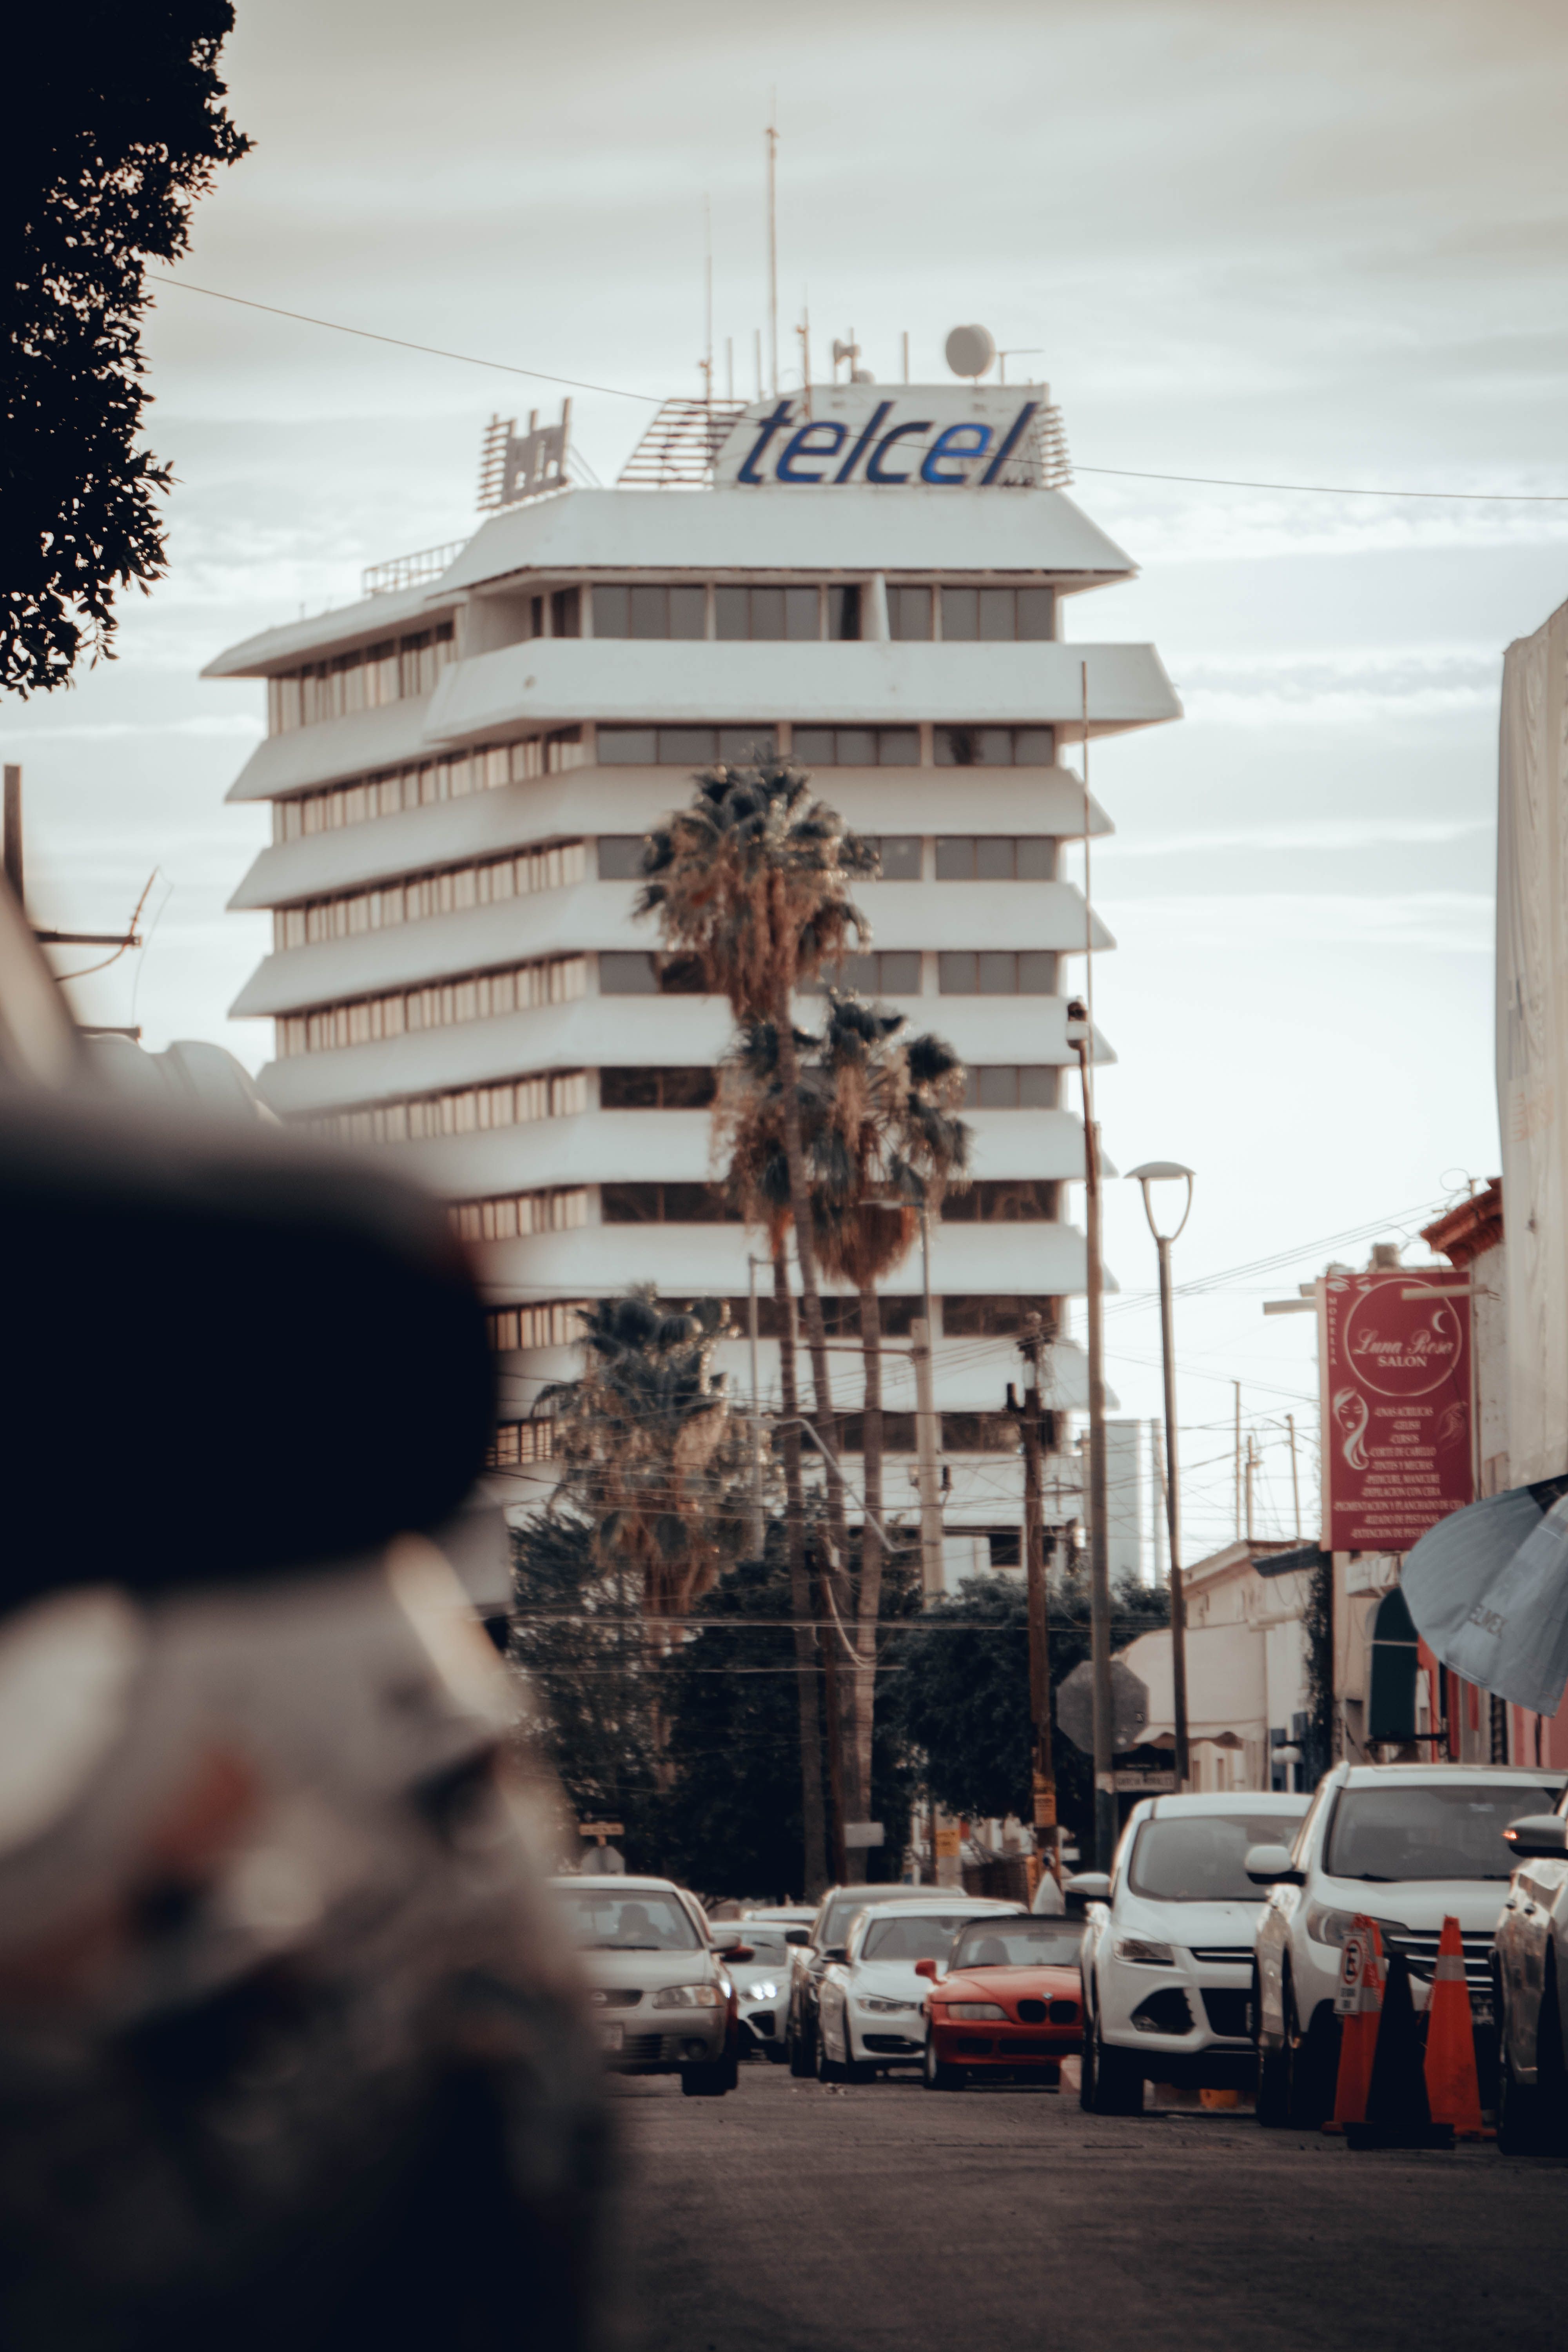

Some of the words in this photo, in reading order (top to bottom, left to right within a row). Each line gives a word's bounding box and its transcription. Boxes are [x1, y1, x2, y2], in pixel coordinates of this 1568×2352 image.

[737, 400, 1041, 486] telcel
[1353, 1329, 1403, 1354] Luna
[1377, 1356, 1427, 1367] SALON
